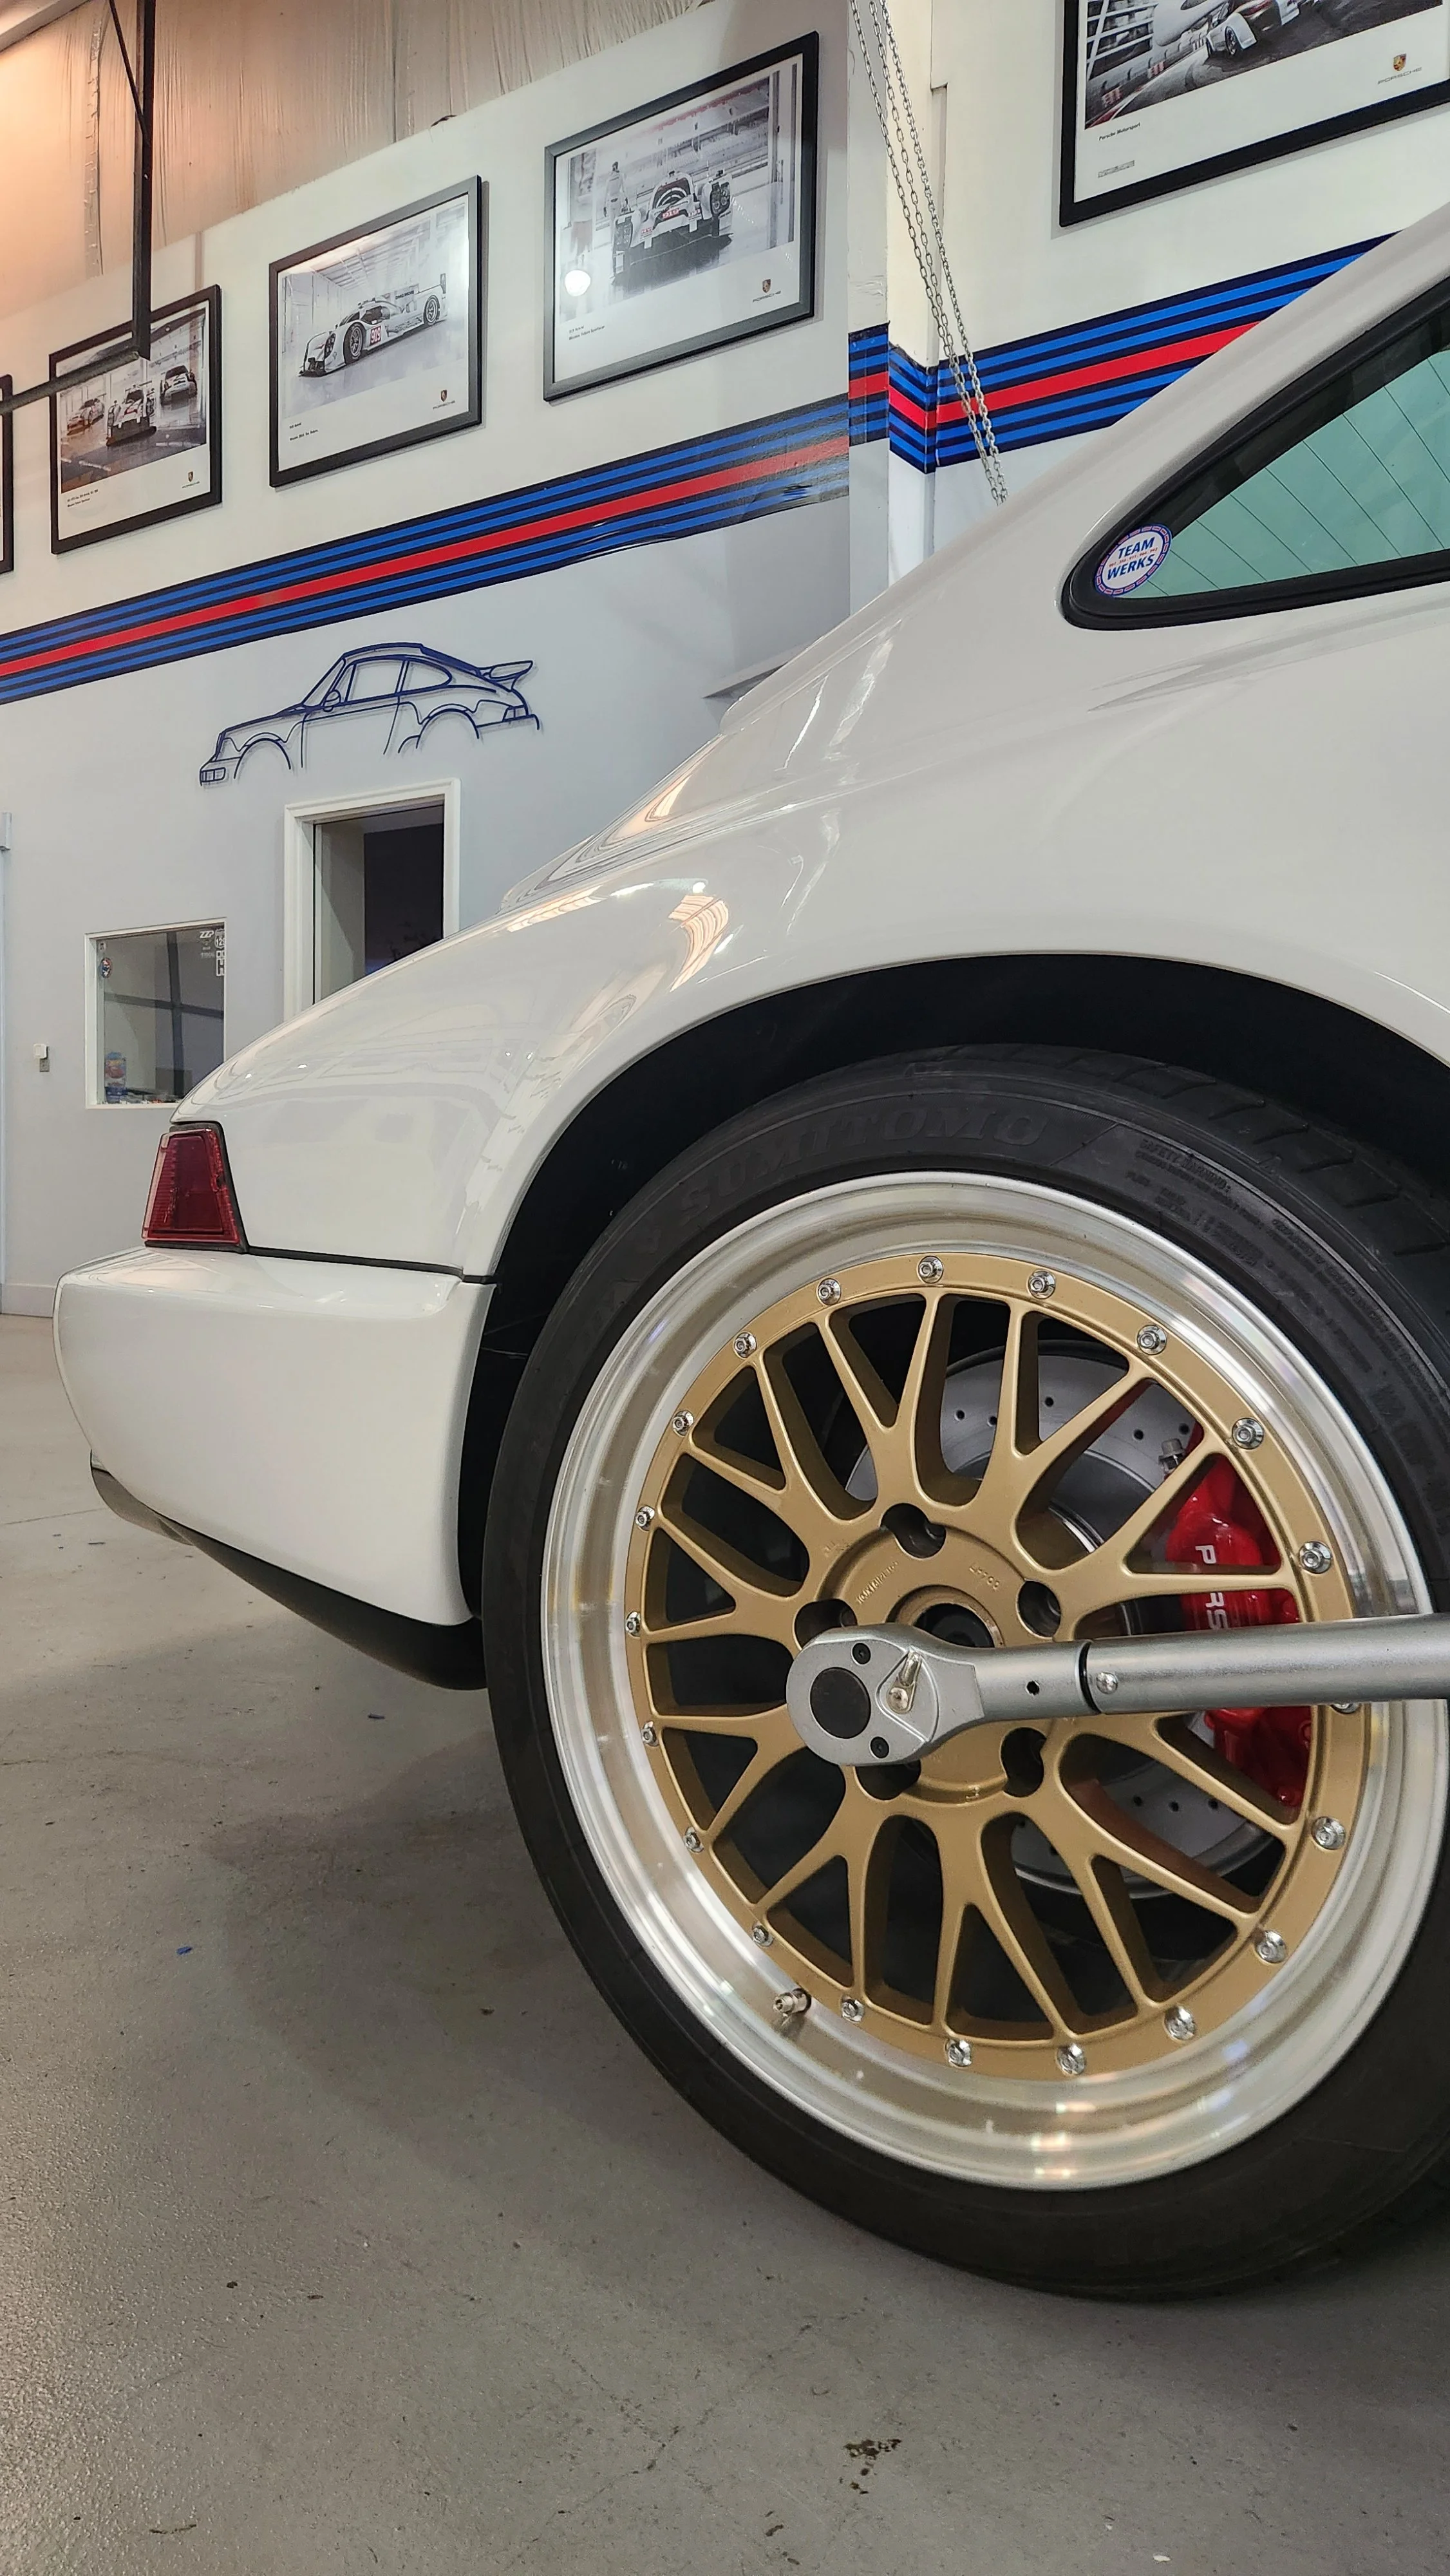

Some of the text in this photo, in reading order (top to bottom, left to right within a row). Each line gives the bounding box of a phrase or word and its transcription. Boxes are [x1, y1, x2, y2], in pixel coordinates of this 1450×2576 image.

[1377, 66, 1422, 84] PORSCHE
[370, 327, 381, 344] 919
[1118, 536, 1156, 560] TEAM
[1107, 553, 1155, 580] WERKS
[680, 1106, 1050, 1225] SUMITOMO
